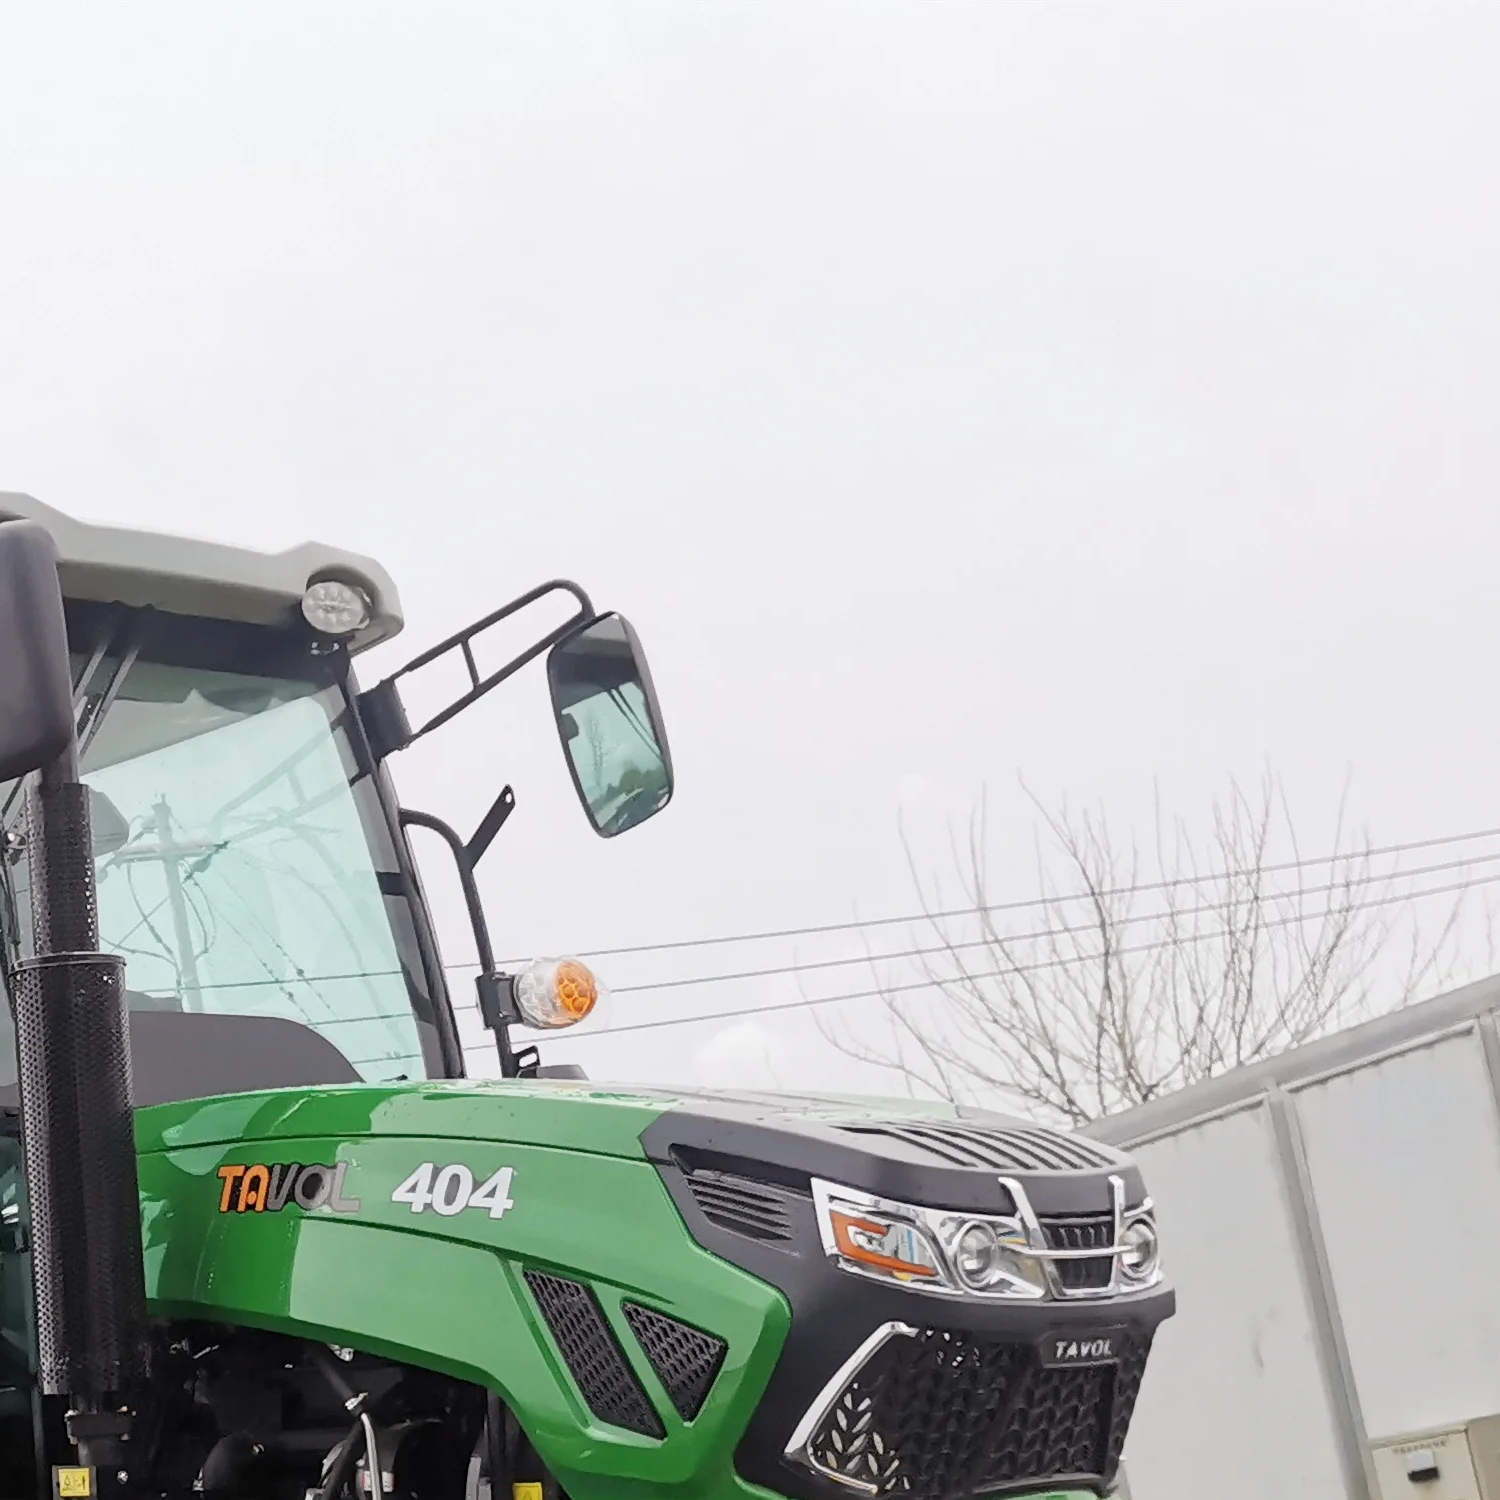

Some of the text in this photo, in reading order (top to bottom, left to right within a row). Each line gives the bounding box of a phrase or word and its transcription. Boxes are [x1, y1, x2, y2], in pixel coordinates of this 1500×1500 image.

[217, 1161, 515, 1219] TAVOL 404
[1055, 1338, 1113, 1360] TAVOL
